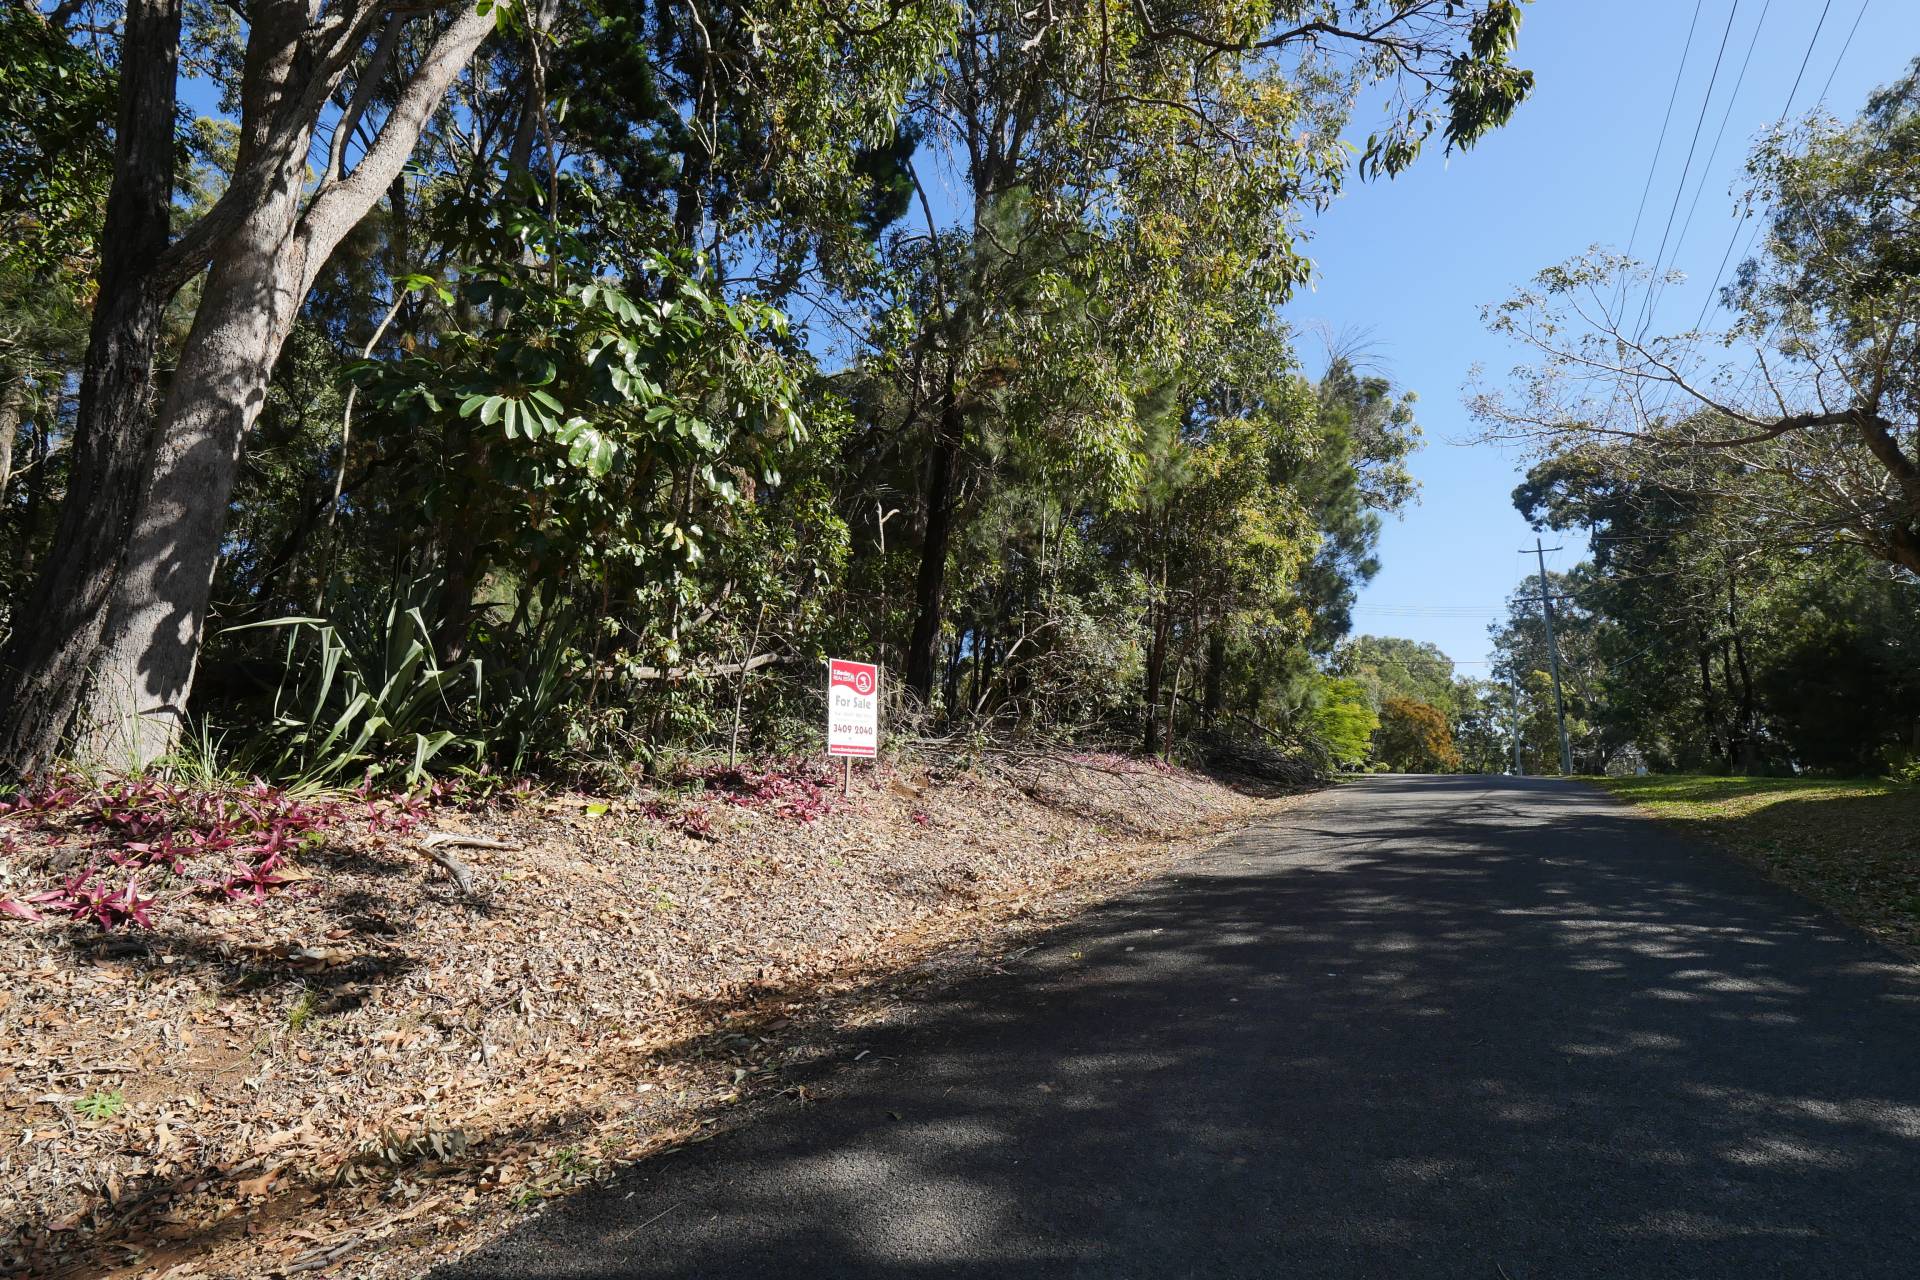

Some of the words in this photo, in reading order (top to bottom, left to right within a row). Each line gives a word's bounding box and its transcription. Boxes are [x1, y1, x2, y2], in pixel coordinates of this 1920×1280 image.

[835, 695, 850, 707] For
[853, 697, 871, 709] Sale
[833, 724, 852, 733] 3409
[854, 725, 873, 735] 2040
